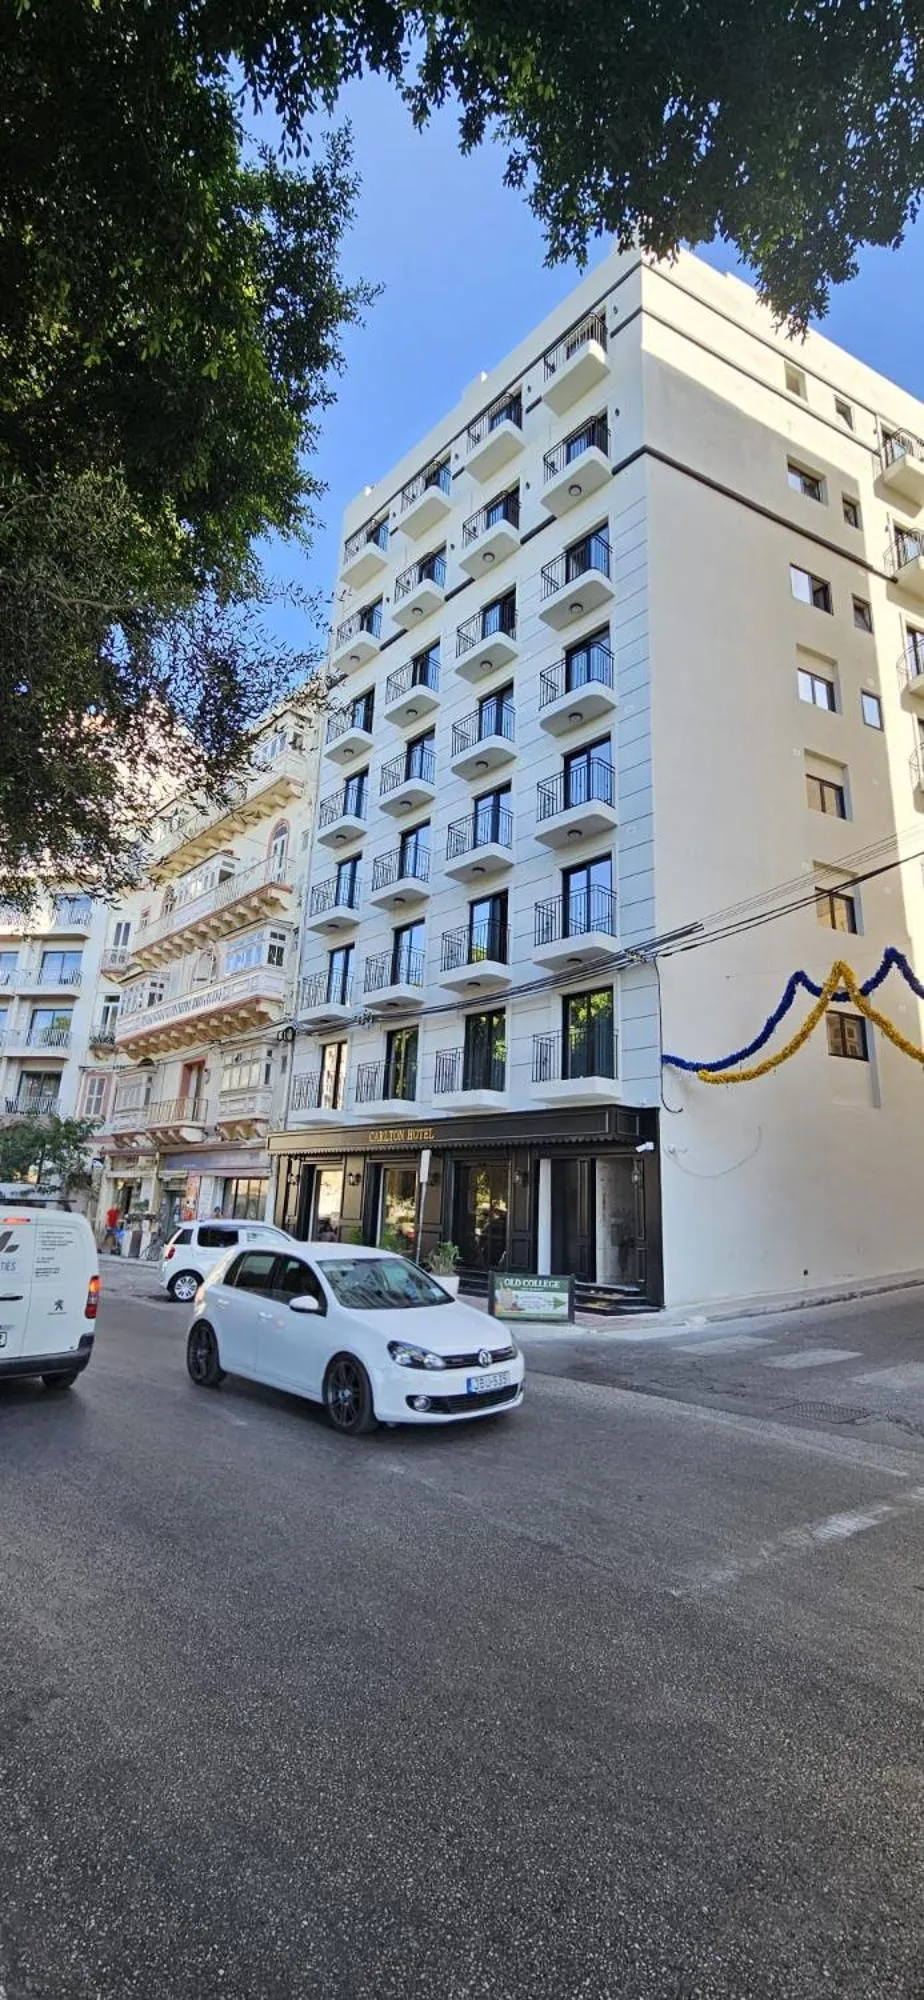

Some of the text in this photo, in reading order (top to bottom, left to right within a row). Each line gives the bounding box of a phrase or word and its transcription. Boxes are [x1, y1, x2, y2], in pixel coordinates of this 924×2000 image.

[369, 1128, 434, 1142] CARLTON HOTEL
[504, 1278, 521, 1287] OLD
[523, 1279, 560, 1289] COLLEGE
